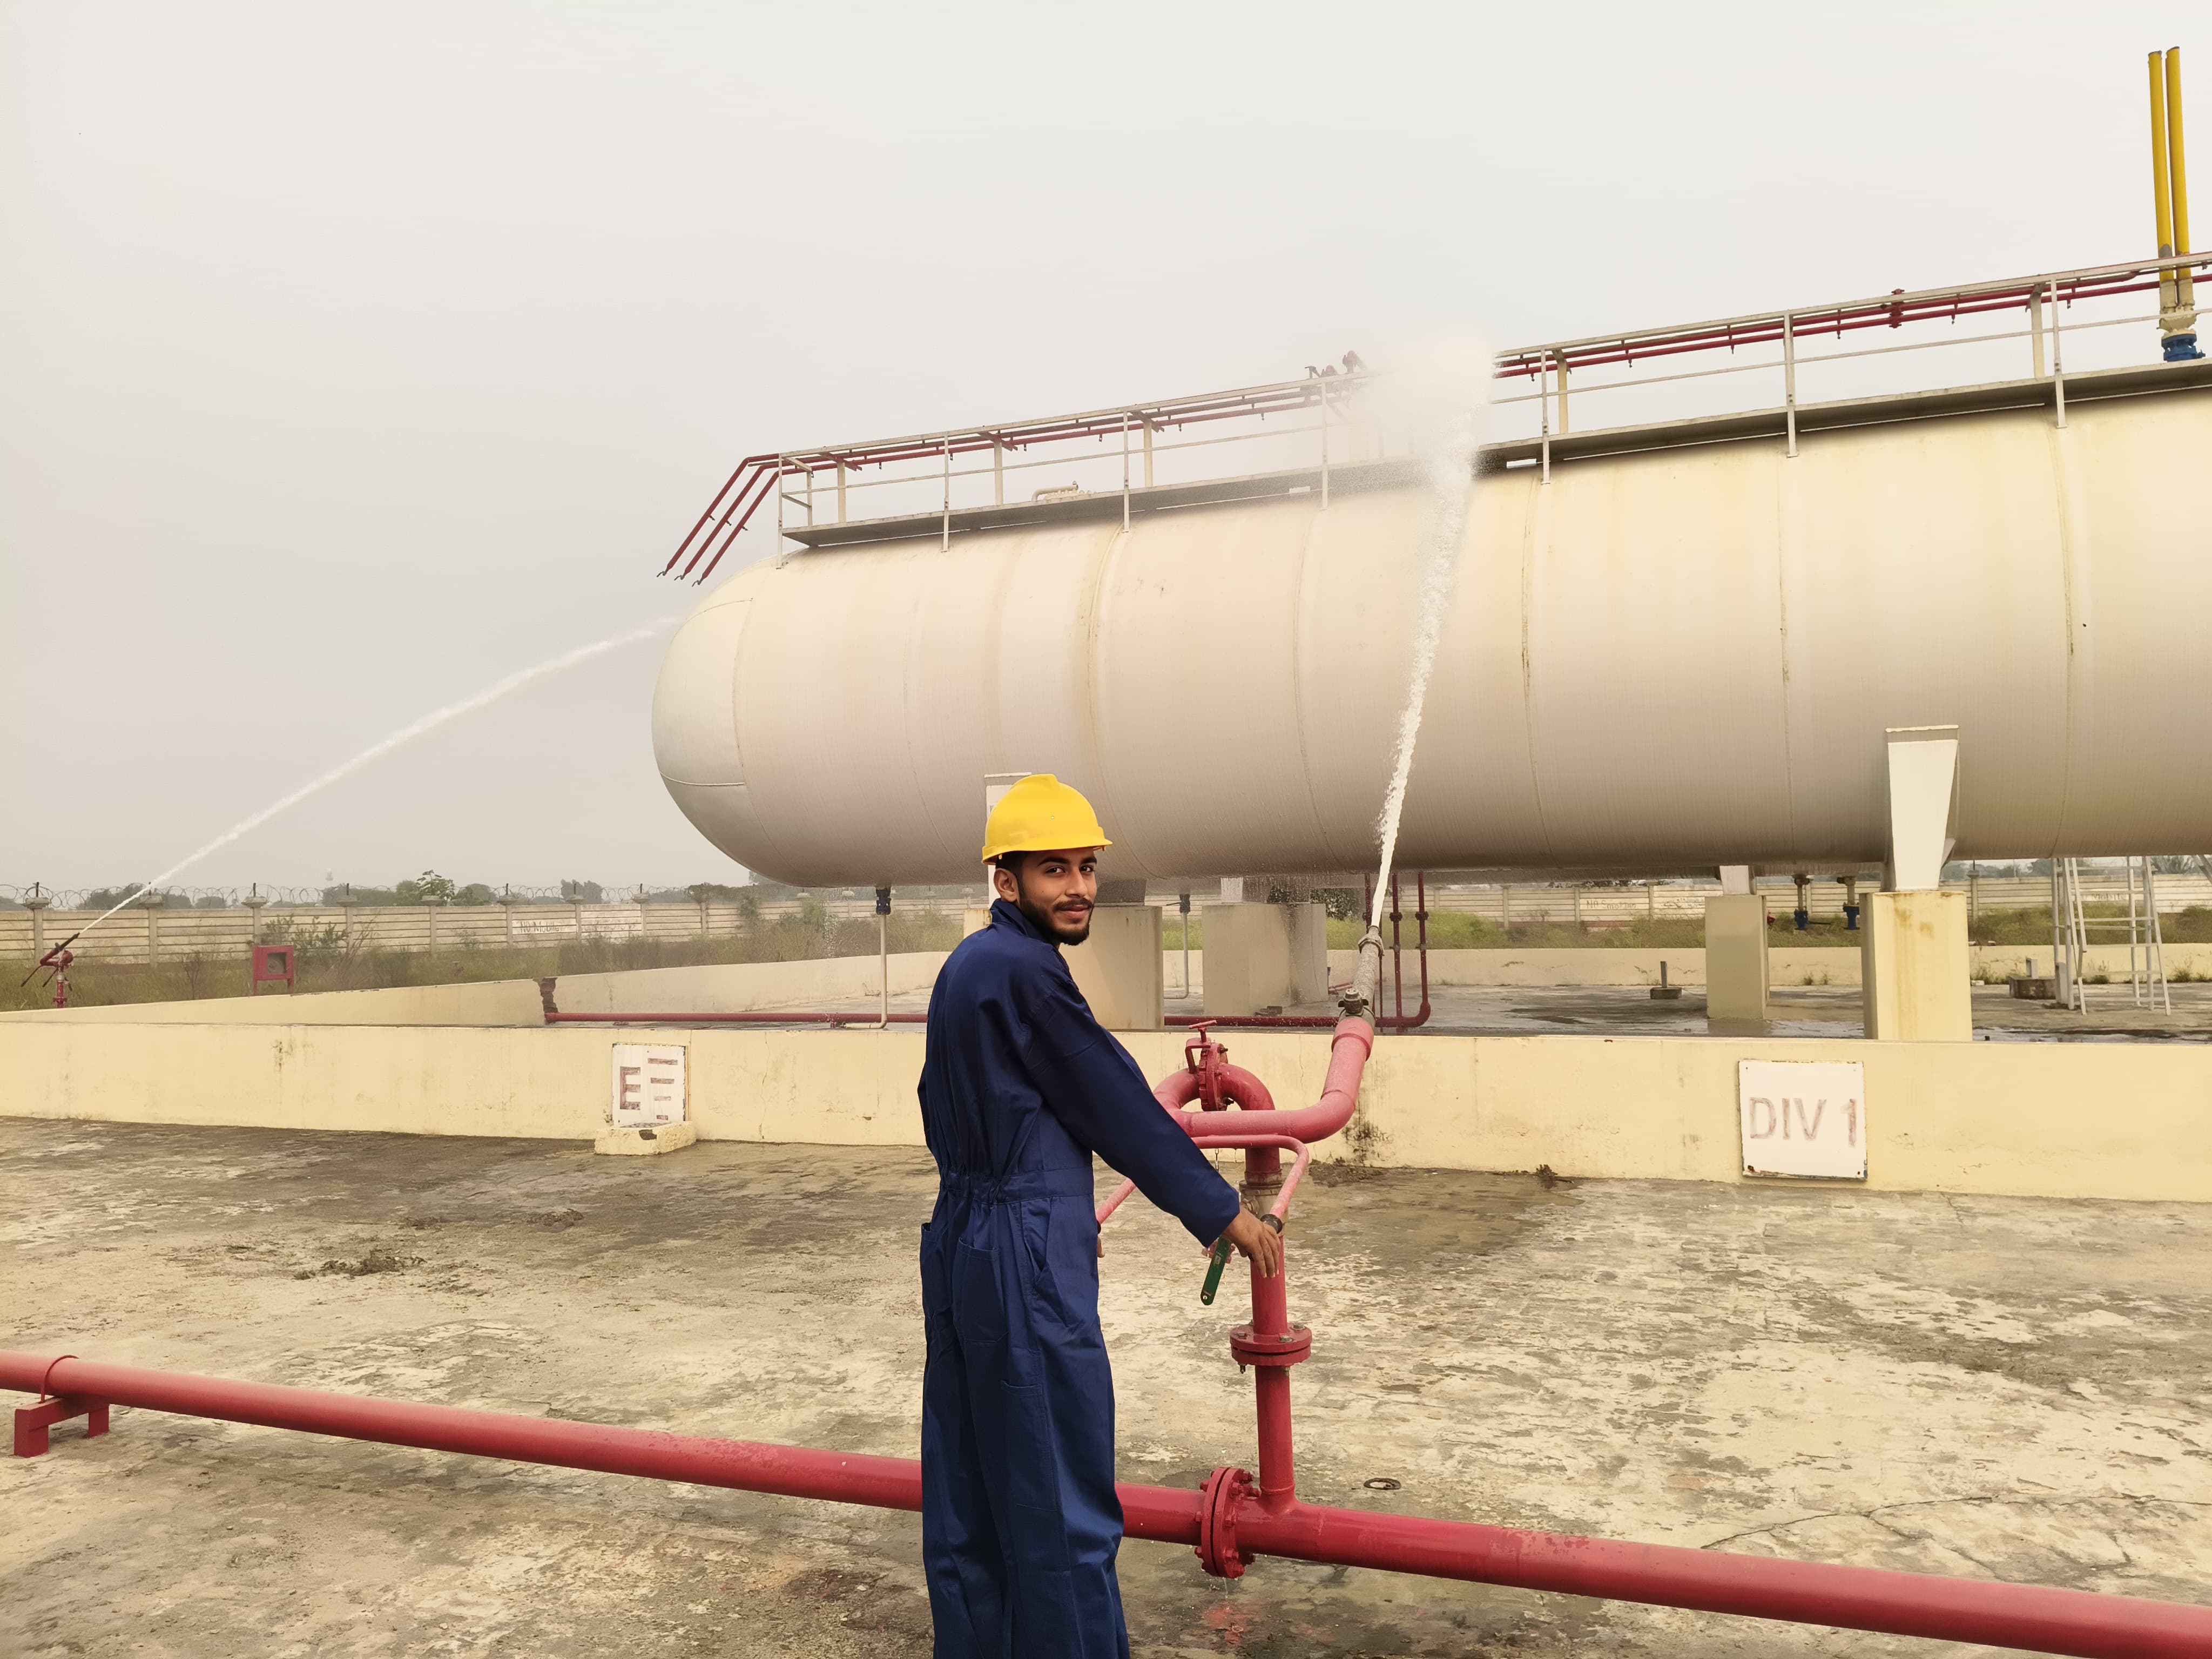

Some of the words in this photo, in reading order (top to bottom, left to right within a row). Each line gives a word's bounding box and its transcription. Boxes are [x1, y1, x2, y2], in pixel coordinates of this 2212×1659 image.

[520, 921, 531, 933] NO
[619, 1066, 641, 1110] E
[1749, 1097, 1827, 1142] DIV
[1839, 1098, 1858, 1148] 1
